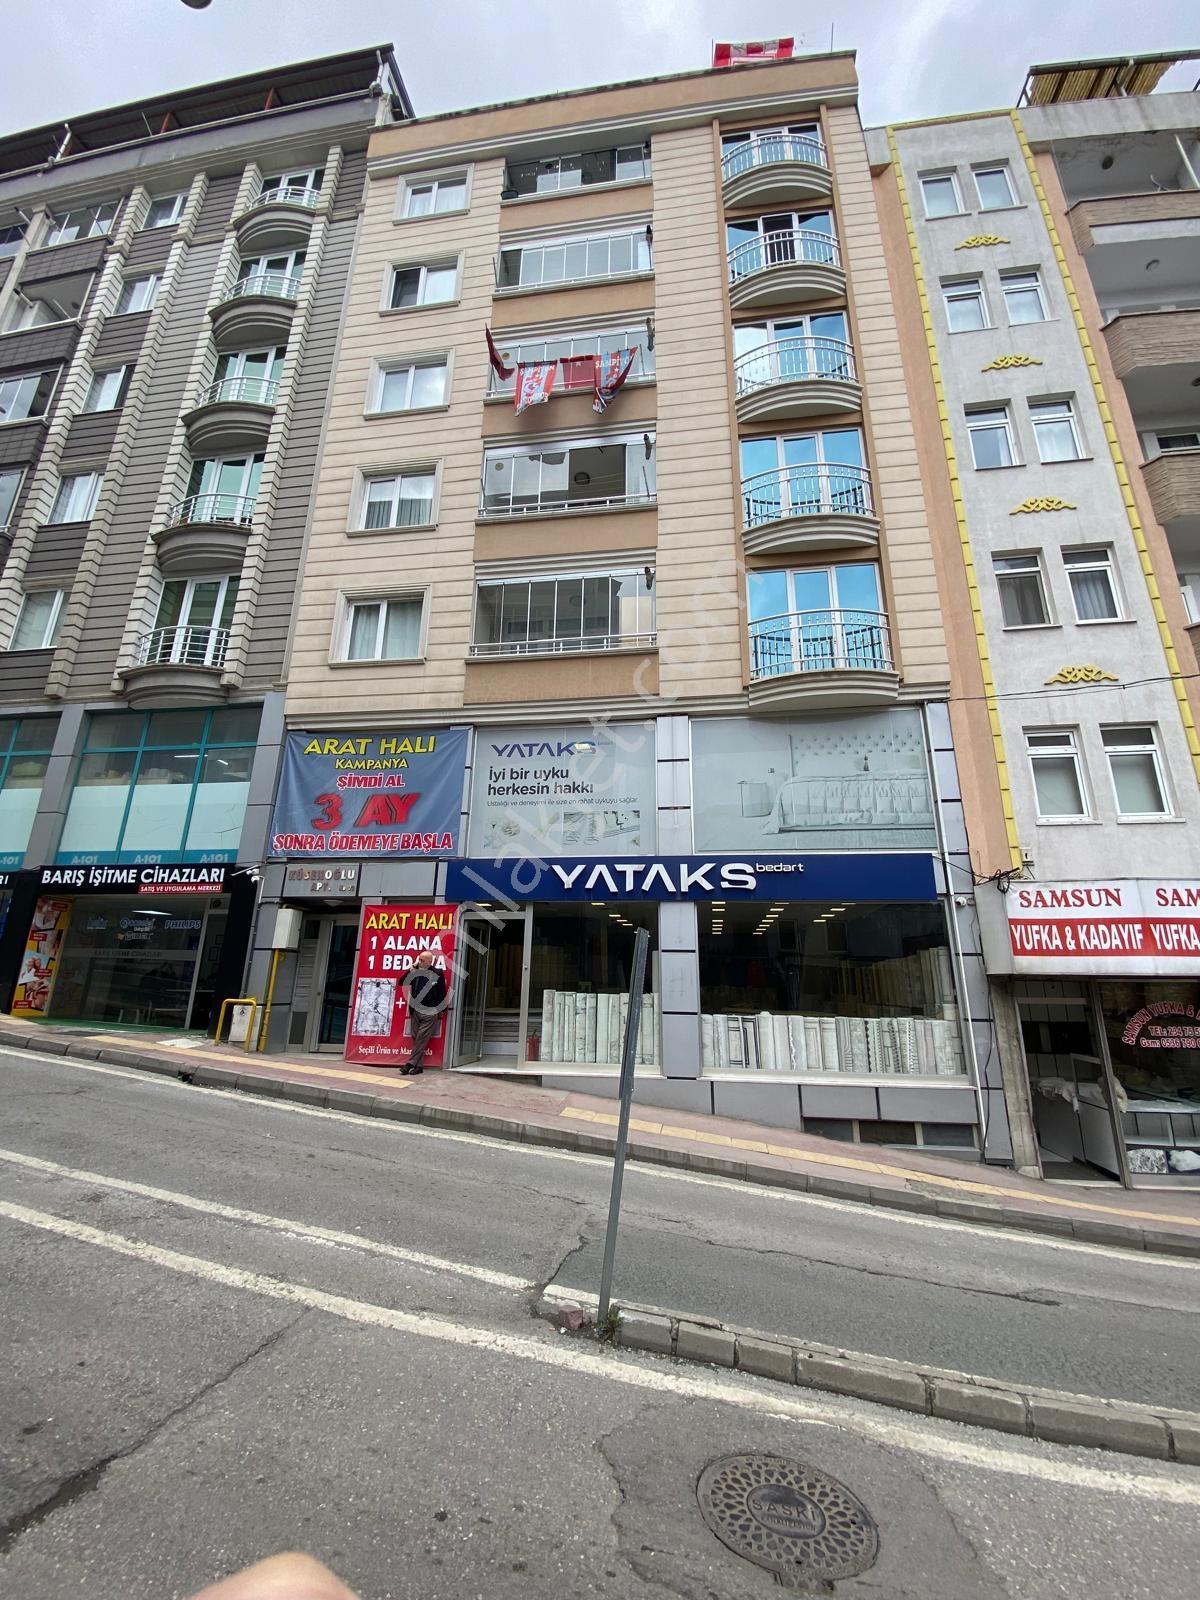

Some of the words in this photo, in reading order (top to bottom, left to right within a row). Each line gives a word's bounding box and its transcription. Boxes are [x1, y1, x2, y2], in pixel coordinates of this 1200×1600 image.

[304, 737, 373, 755] ARAT
[380, 736, 436, 755] HALI
[335, 758, 409, 770] KAMPANYA
[337, 773, 383, 791] ŞİMDİ
[384, 775, 405, 788] AL
[489, 766, 506, 782] İyi
[510, 767, 530, 780] bir
[534, 766, 569, 782] uyku
[488, 782, 550, 796] herkesin
[554, 781, 594, 794] hakkı
[311, 792, 344, 830] 3
[353, 792, 421, 828] AY
[273, 834, 325, 851] SONRA
[328, 831, 400, 851] ÖDEMEYE
[400, 832, 452, 853] BAŞLA
[41, 869, 86, 886] BARIŞ
[88, 866, 138, 886] İŞİTME
[140, 865, 225, 883] CİHAZLARI
[551, 862, 757, 893] YATAKS
[756, 862, 804, 873] bedart
[1018, 888, 1122, 908] SAMSUN
[164, 919, 201, 929] PHILIPS
[365, 913, 411, 930] ARAT
[414, 913, 453, 930] HALI
[370, 936, 378, 950] 1
[383, 935, 443, 950] ALANA
[1011, 924, 1063, 950] YUFKA
[1065, 926, 1076, 950] &
[1077, 923, 1144, 950] KADAYIF
[1150, 923, 1200, 950] YUFKA
[368, 955, 375, 970] 1
[1122, 1008, 1152, 1045] SAMSUN
[1147, 1001, 1184, 1017] YUFKA
[358, 1045, 376, 1056] Seçili
[376, 1044, 391, 1054] Ürün
[752, 1499, 817, 1522] SASKİ
